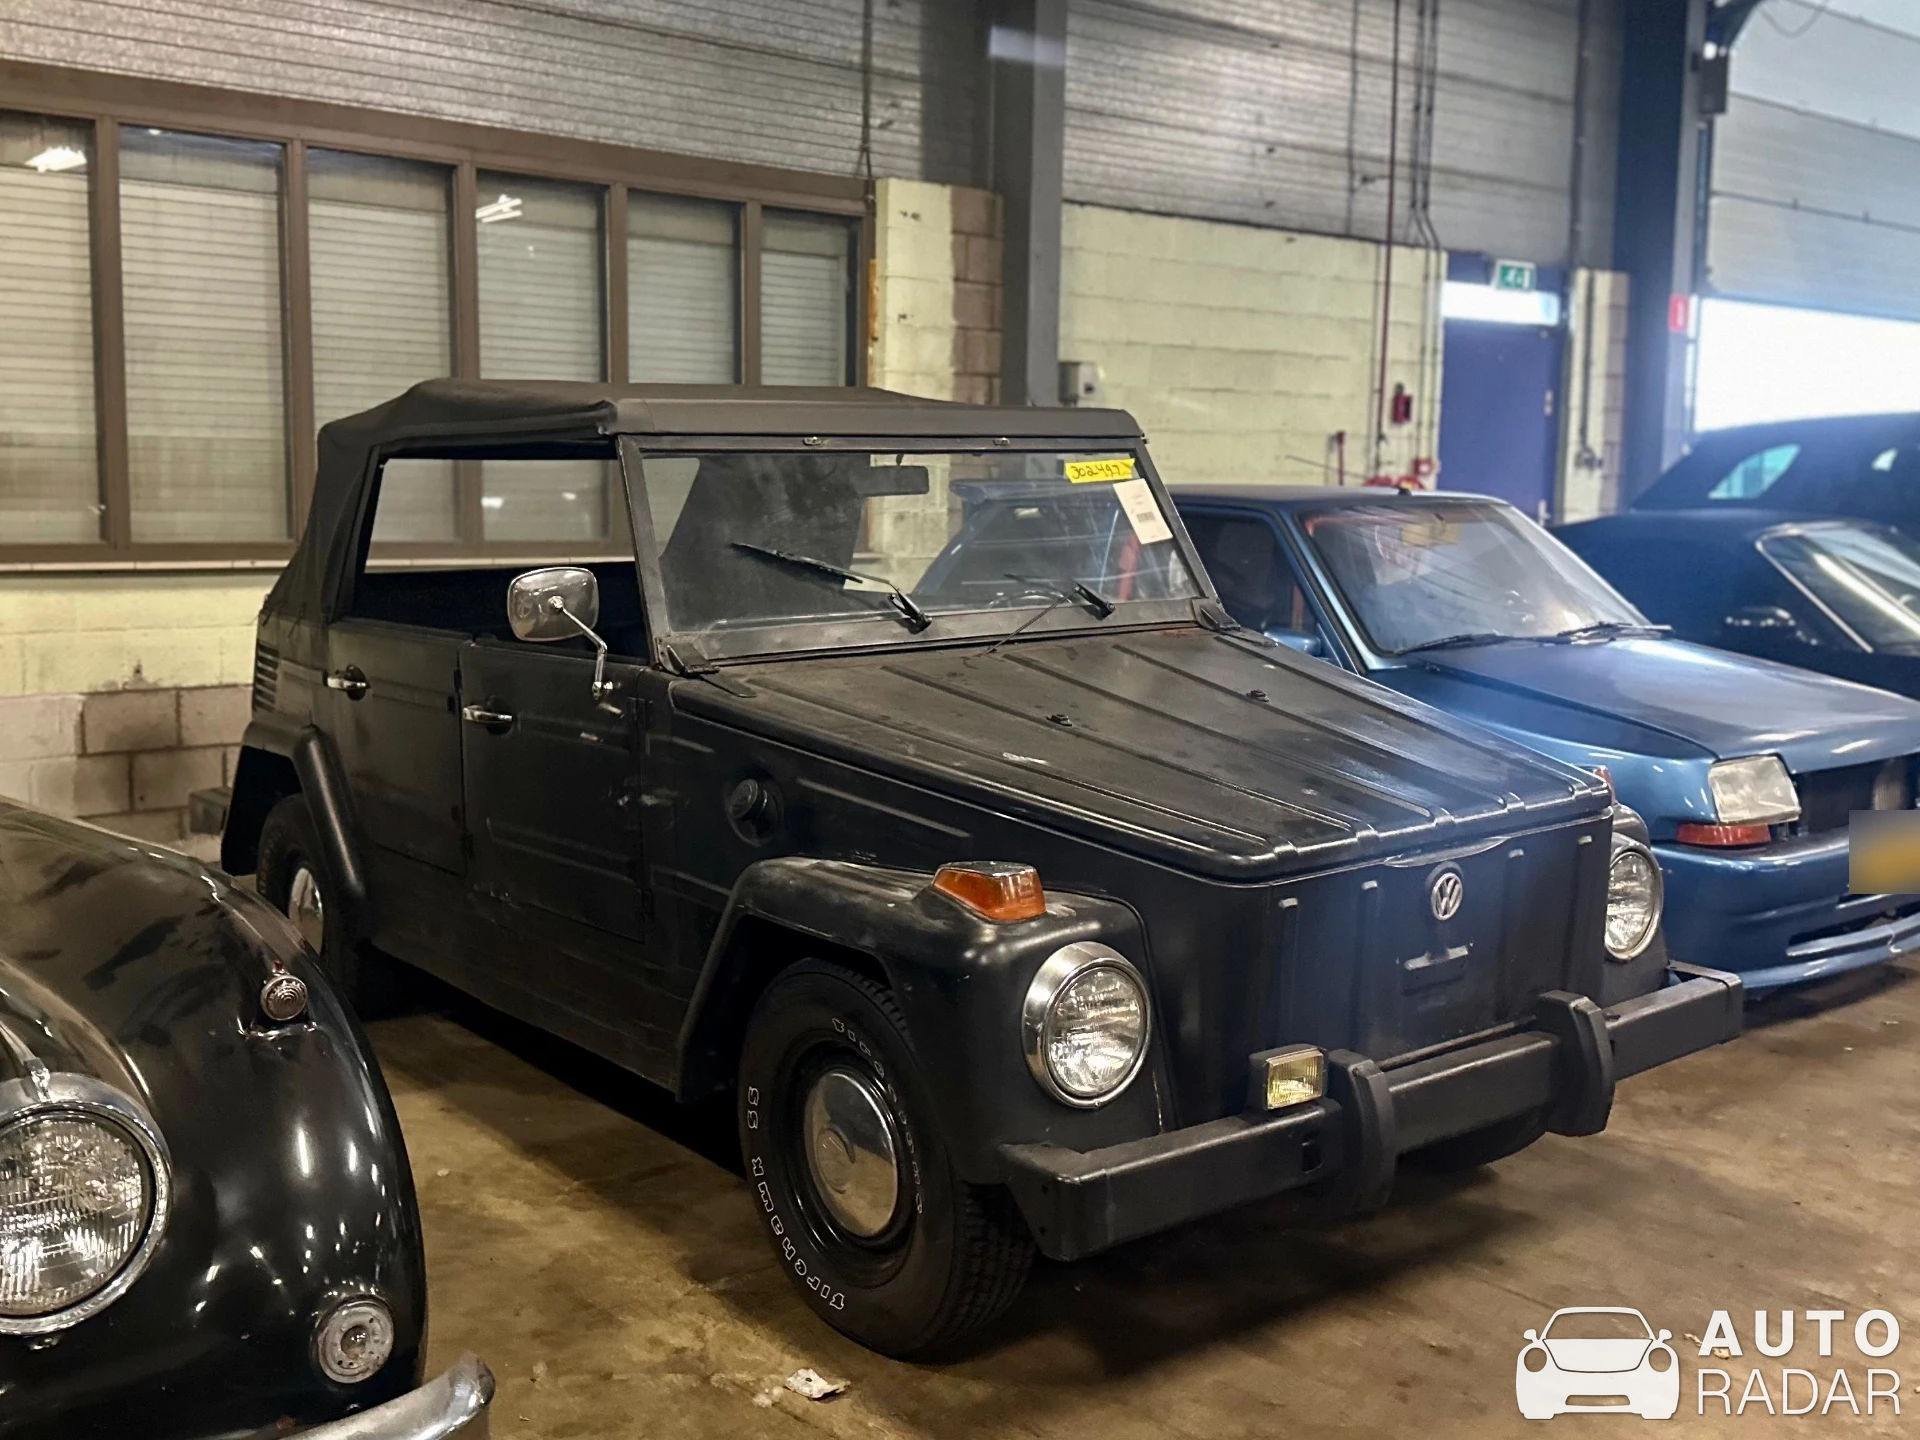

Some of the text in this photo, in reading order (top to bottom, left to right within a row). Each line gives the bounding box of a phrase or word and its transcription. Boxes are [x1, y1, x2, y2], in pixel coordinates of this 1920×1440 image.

[1070, 463, 1122, 480] 302497
[1431, 873, 1463, 920] VW
[747, 1086, 760, 1130] SS
